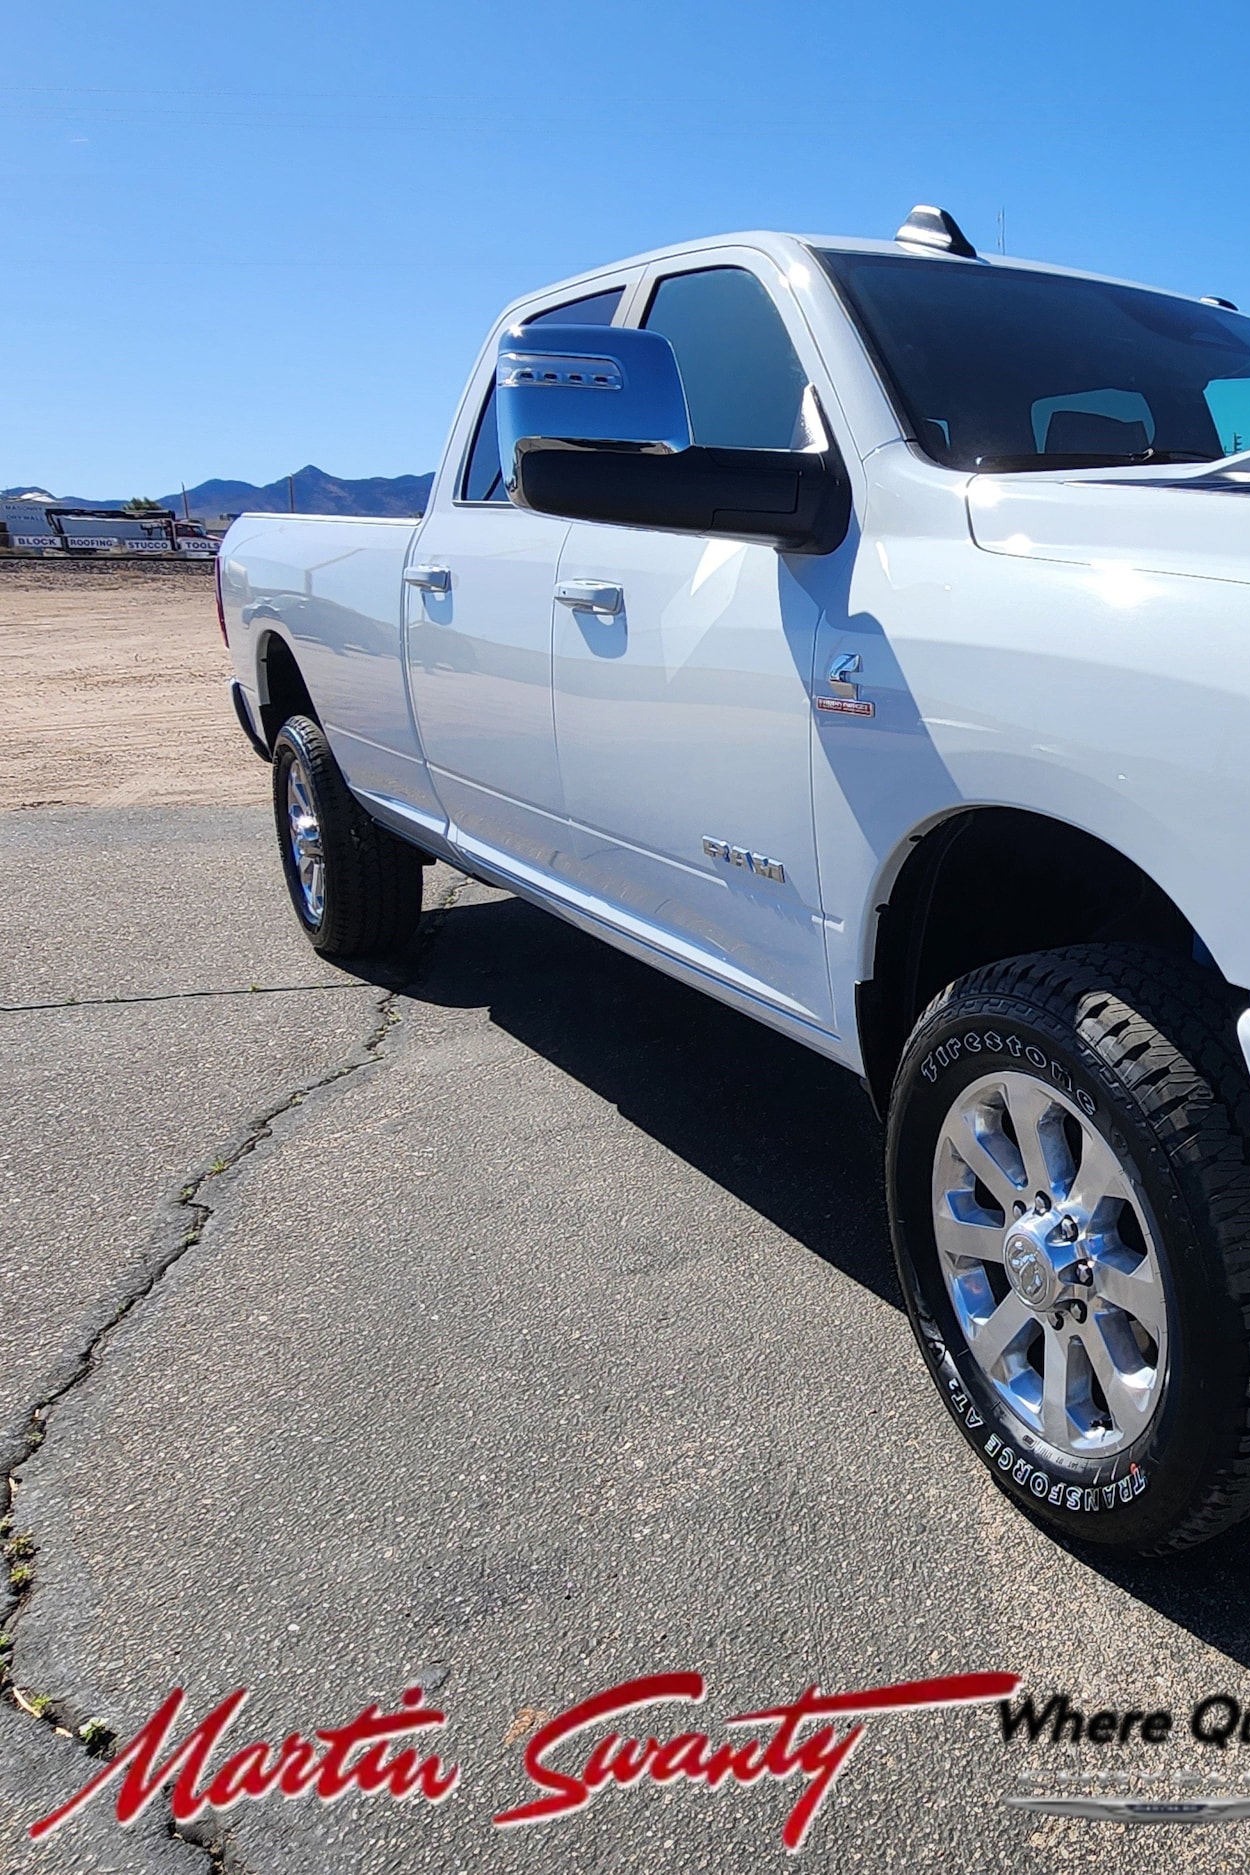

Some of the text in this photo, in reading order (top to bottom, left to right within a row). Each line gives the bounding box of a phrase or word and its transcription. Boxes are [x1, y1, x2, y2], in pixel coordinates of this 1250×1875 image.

[17, 537, 57, 546] BLOCK
[69, 538, 113, 547] ROOFING
[127, 541, 168, 549] STUCCO
[185, 541, 220, 550] TOOLS
[702, 835, 785, 883] RAM
[983, 1433, 1148, 1512] TRANSFORCE
